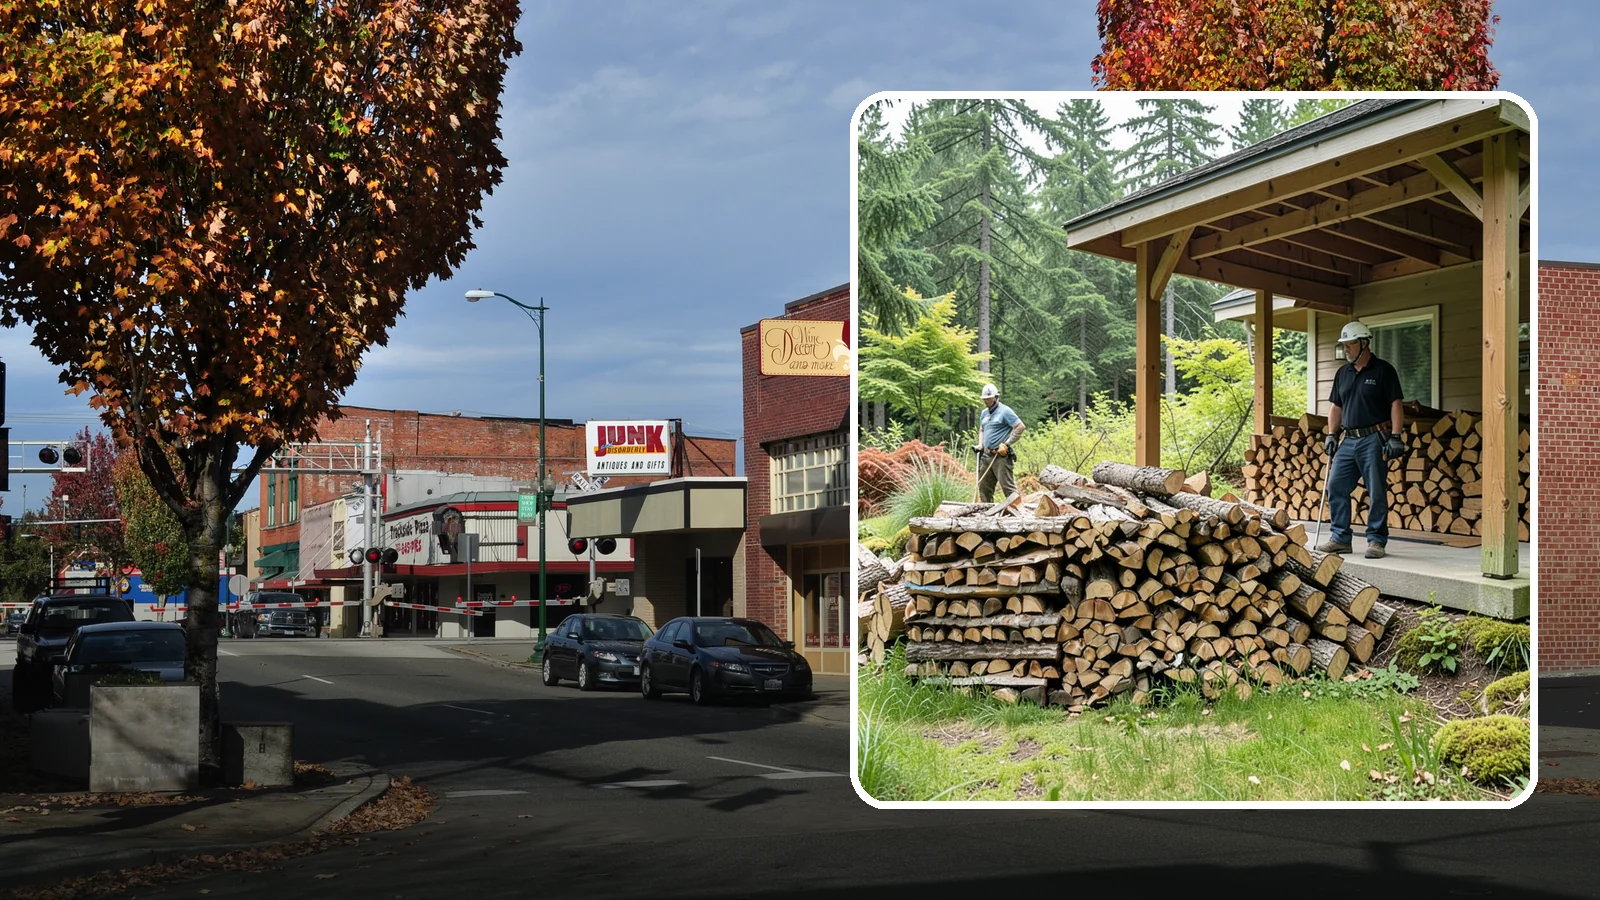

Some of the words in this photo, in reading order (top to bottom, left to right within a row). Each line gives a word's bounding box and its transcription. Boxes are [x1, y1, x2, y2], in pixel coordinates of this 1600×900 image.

[765, 328, 831, 365] Decor
[595, 425, 665, 457] JUNK
[608, 446, 645, 454] DISORDERLY
[597, 461, 628, 470] ANTIQUES
[631, 461, 643, 470] AND
[647, 460, 665, 469] GIFTS
[390, 522, 413, 540] Trackside
[414, 519, 429, 535] Pizza
